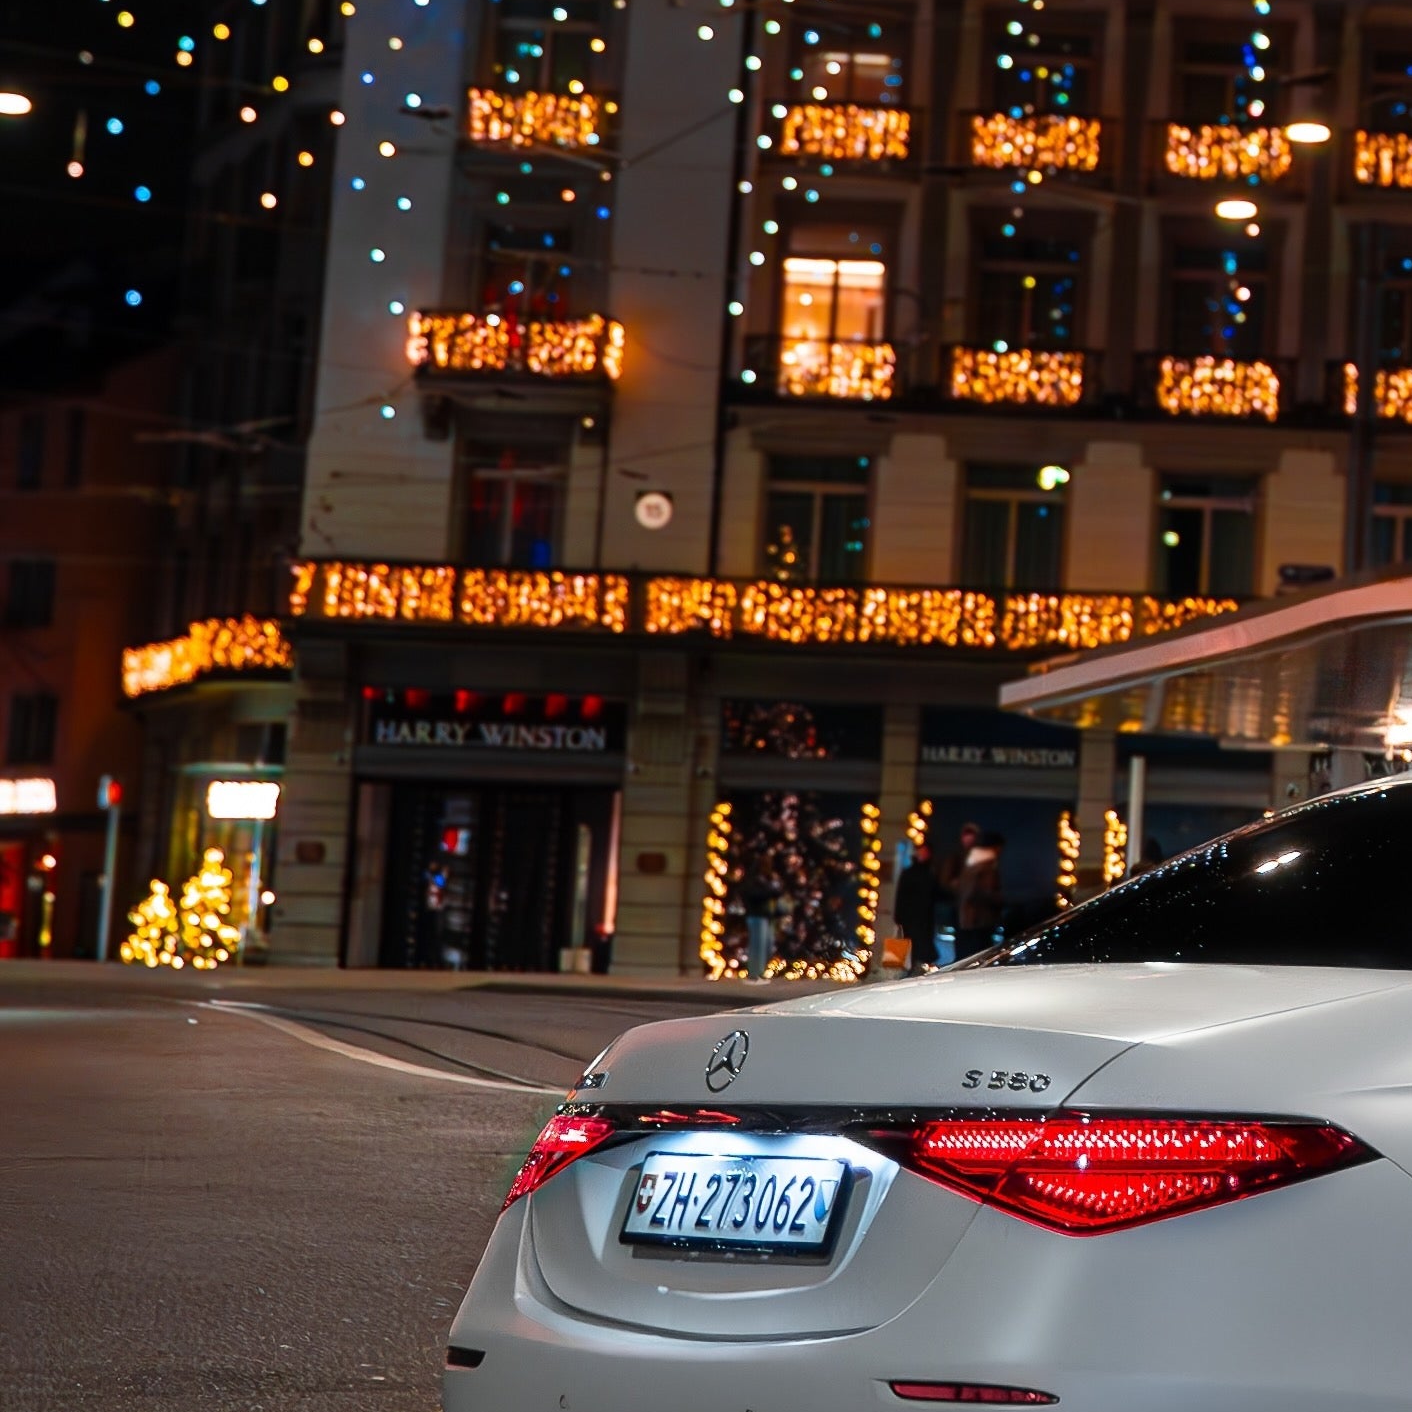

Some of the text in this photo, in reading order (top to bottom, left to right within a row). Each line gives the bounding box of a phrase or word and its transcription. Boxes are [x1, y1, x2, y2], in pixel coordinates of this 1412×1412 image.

[375, 718, 606, 750] HARRY WINSTON
[920, 745, 1077, 767] HARRY WINSTON
[961, 1068, 984, 1090] S
